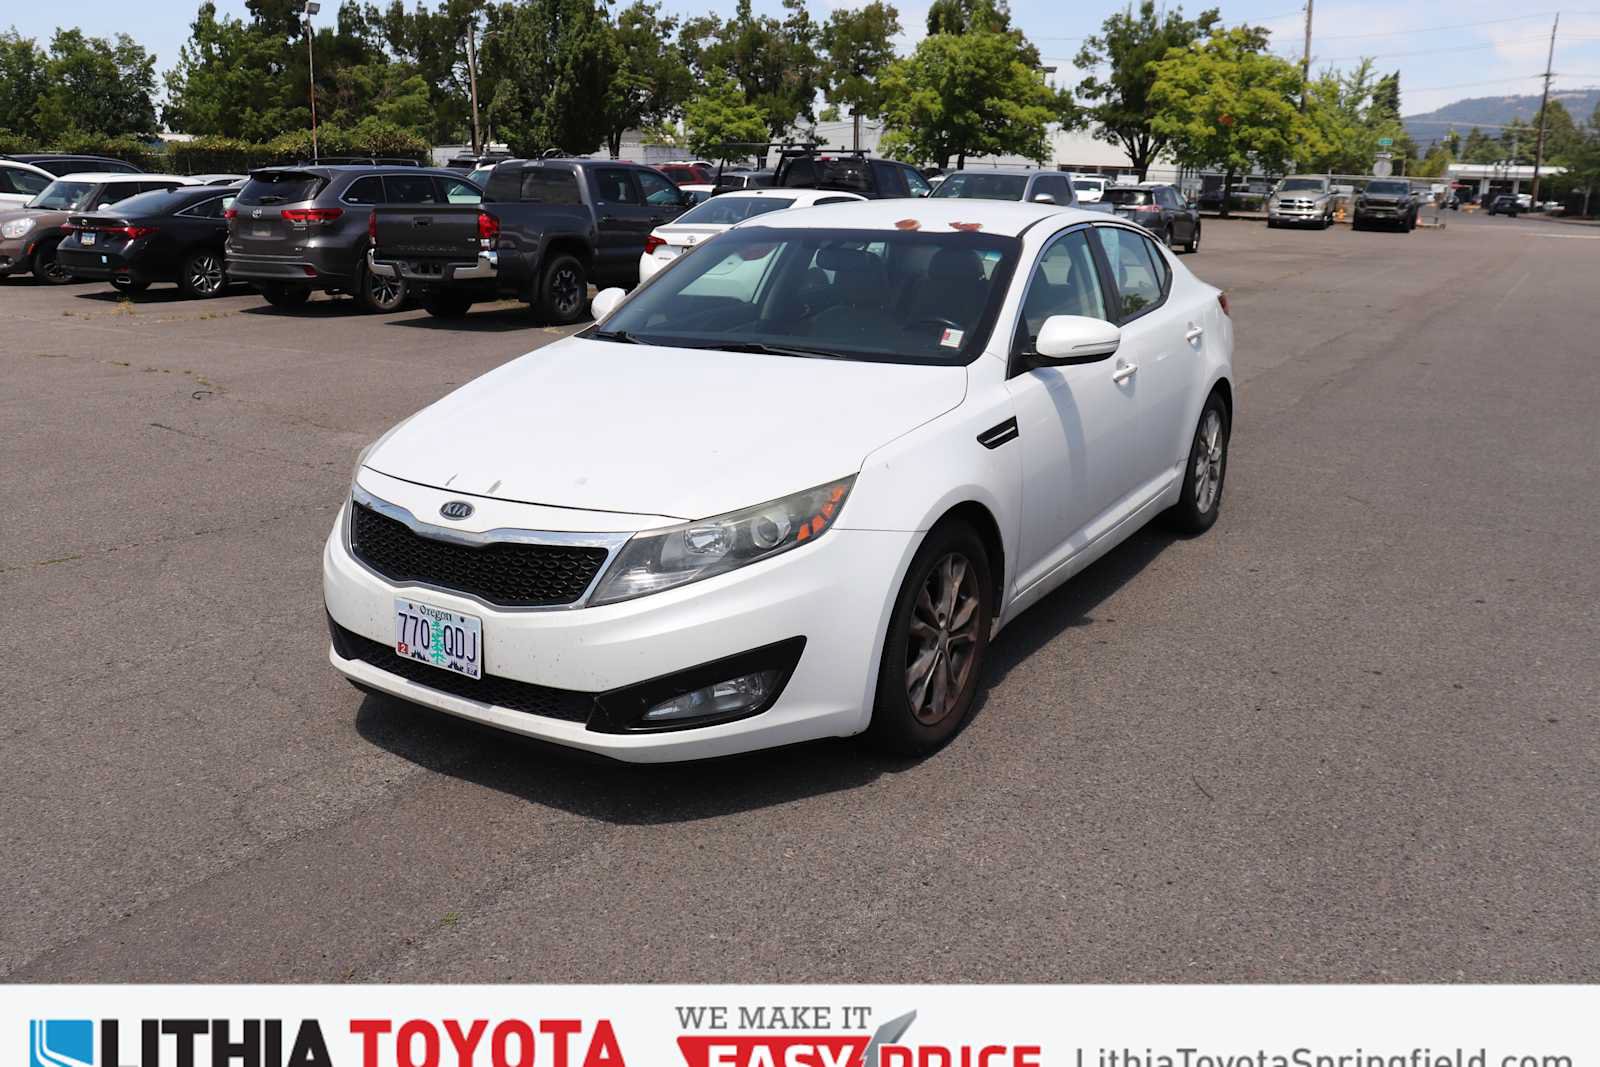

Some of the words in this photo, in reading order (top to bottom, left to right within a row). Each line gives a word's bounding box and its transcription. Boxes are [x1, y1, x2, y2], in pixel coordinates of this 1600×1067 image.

[419, 604, 452, 621] Oregon
[398, 612, 430, 650] 770
[443, 625, 476, 663] QDJ
